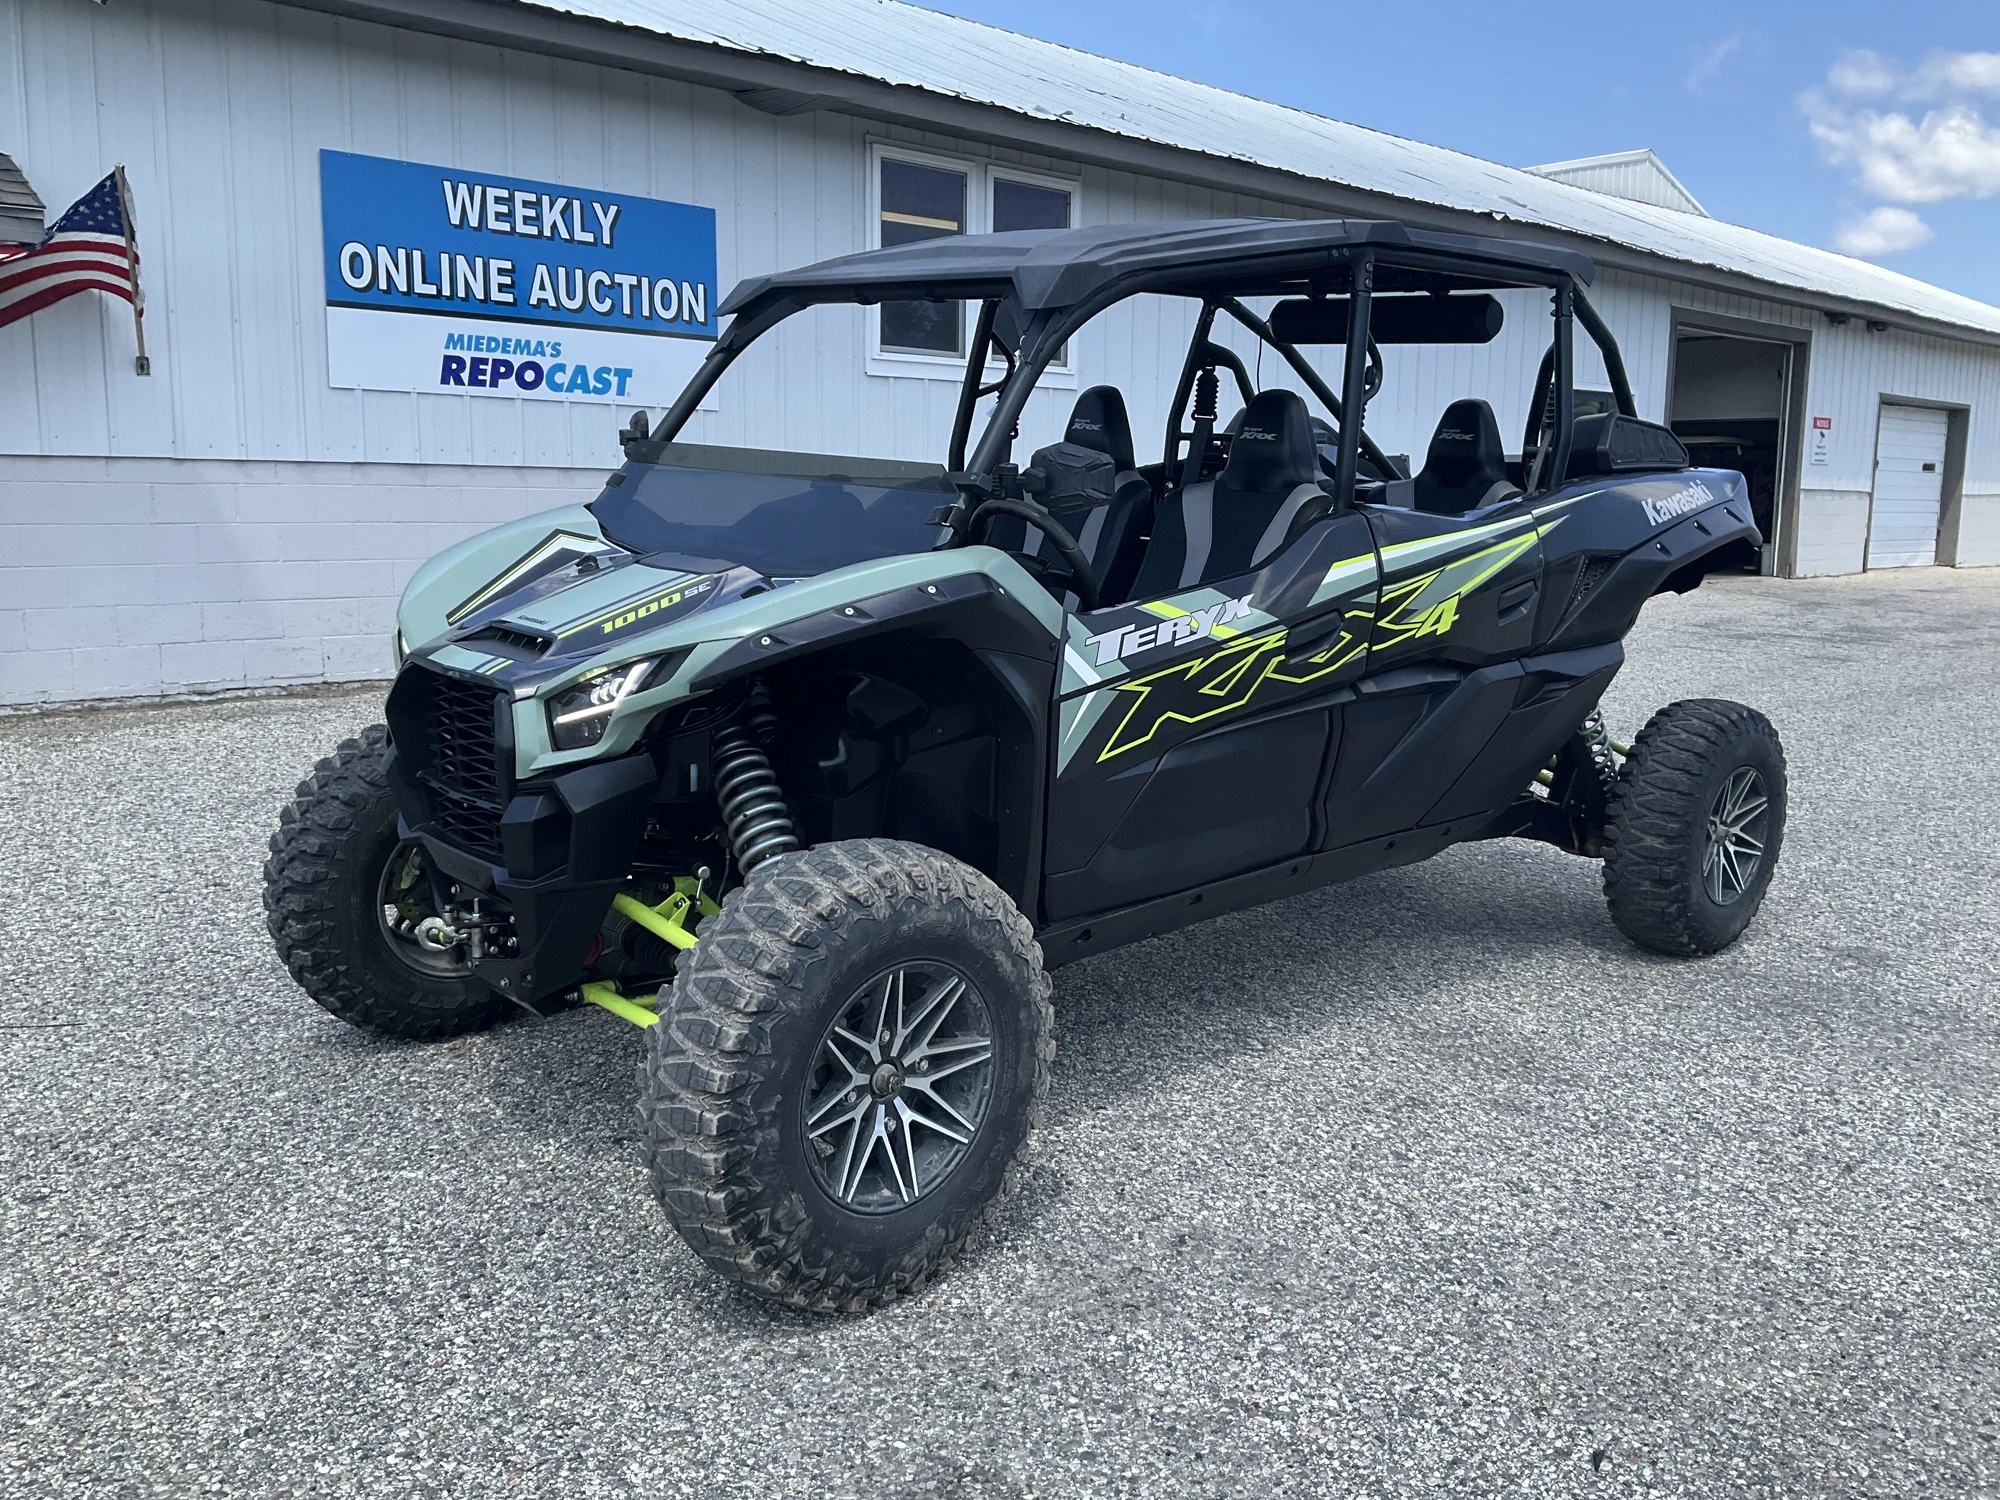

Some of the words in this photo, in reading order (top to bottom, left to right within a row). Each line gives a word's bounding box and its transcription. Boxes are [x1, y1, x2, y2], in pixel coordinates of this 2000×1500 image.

[442, 179, 621, 246] WEEKLY
[339, 240, 515, 303] ONLINE
[528, 263, 706, 323] AUCTION
[444, 333, 562, 358] MIEDEMA'S
[440, 354, 633, 397] REPOCAST
[1071, 422, 1103, 431] KRX
[1239, 431, 1278, 441] KRX
[1437, 432, 1476, 441] KRX
[1641, 479, 1714, 527] Kawasaki
[601, 592, 681, 634] 1000
[684, 581, 711, 598] SE
